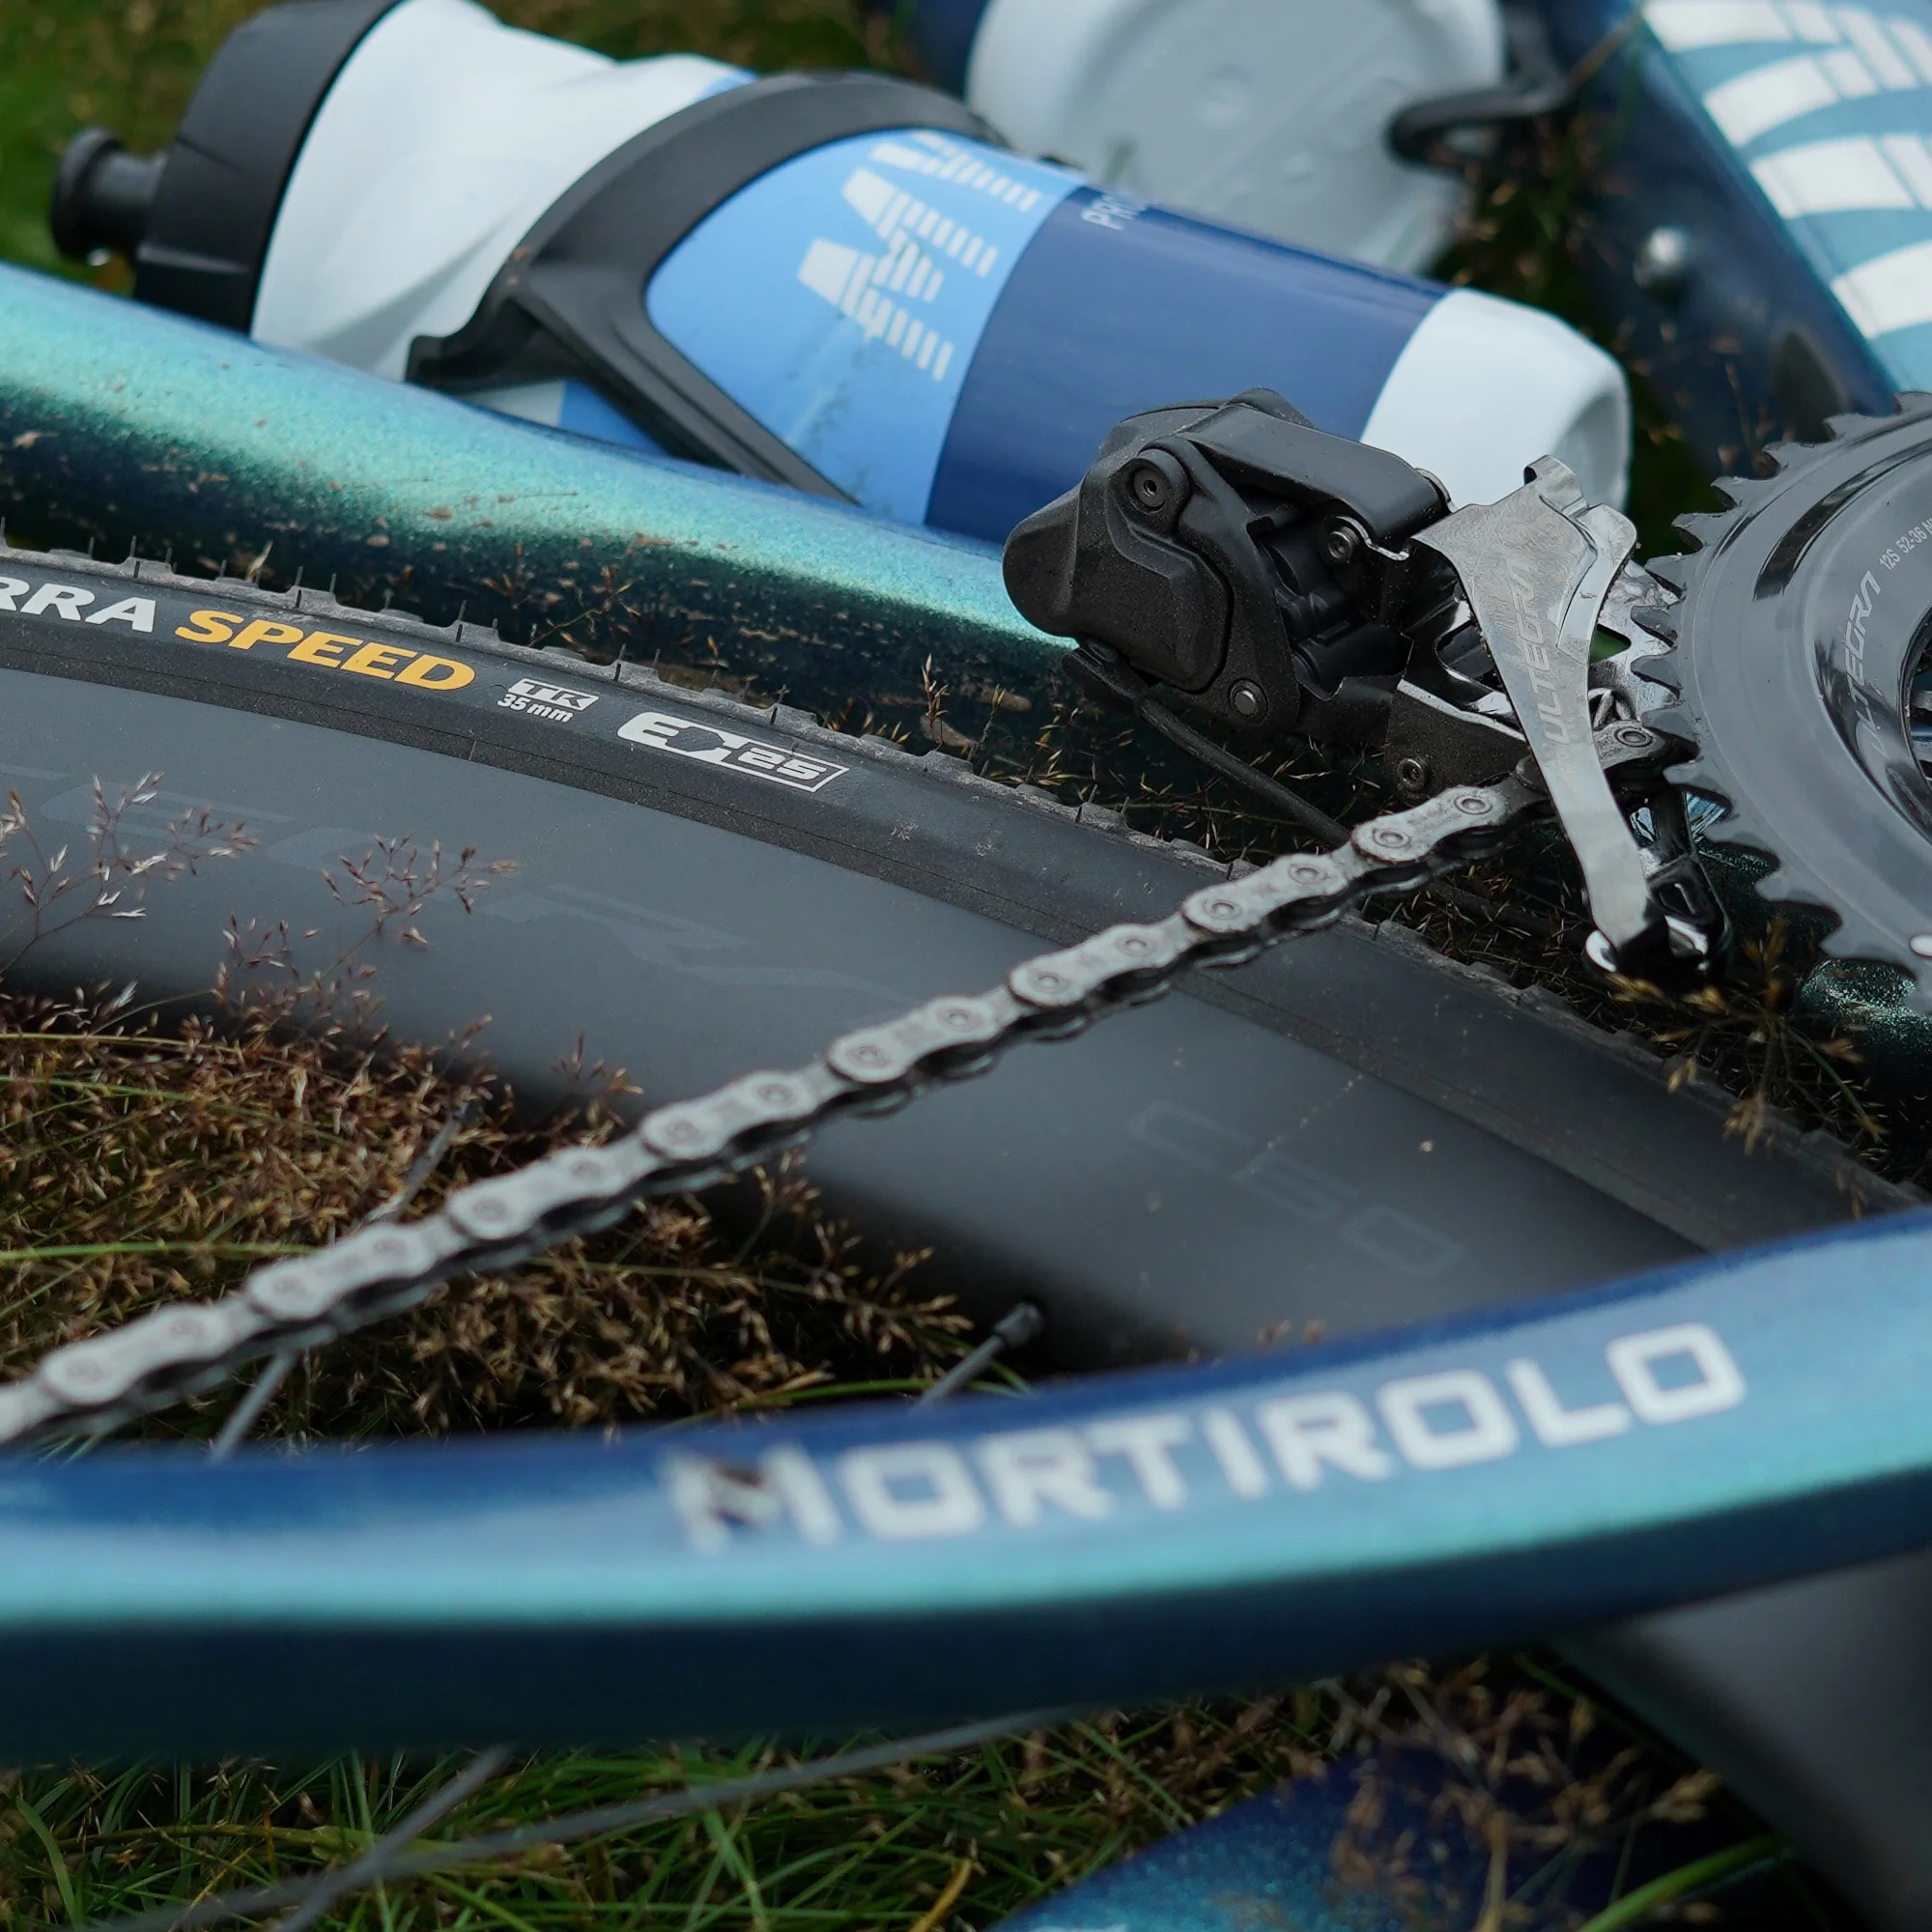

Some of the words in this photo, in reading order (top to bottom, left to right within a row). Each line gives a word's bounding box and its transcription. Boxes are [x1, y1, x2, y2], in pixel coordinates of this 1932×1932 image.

[1878, 548, 1901, 571] 12S
[1895, 526, 1927, 554] 52-36
[174, 609, 475, 691] SPEED
[1503, 556, 1570, 746] ULTEGRA
[1845, 570, 1889, 758] ULTEGRA
[660, 1321, 1746, 1550] MORTIROLO
